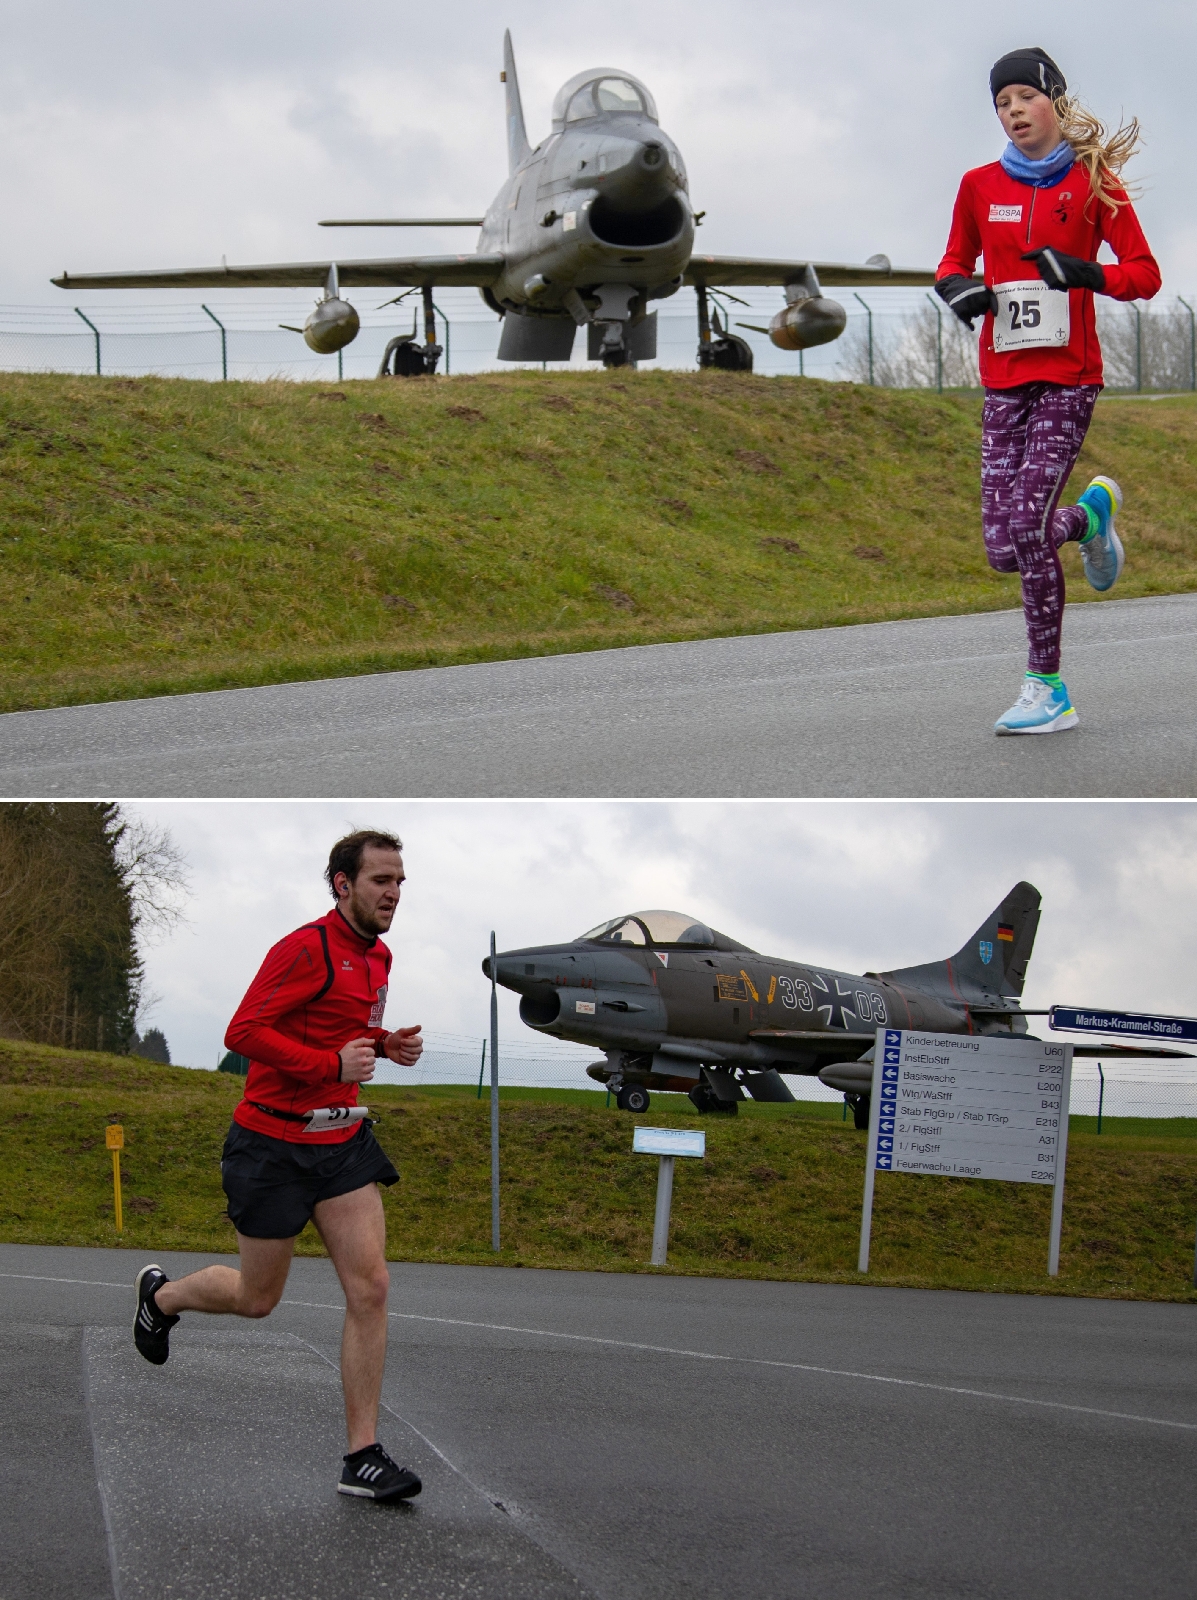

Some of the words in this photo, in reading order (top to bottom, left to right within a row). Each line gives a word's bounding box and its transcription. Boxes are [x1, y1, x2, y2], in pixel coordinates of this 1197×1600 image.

[1008, 300, 1041, 331] 25
[778, 975, 814, 1012] 33
[855, 990, 888, 1025] 03
[1075, 1014, 1183, 1034] Markus-Krammel-Straße
[906, 1036, 980, 1052] Kinderbetreuung
[1044, 1046, 1063, 1056] U60
[903, 1071, 956, 1083] Basiswache
[1038, 1064, 1063, 1074] E222
[1041, 1100, 1060, 1109] B43
[900, 1106, 922, 1116] Stab
[923, 1108, 955, 1120] FlgGrp
[963, 1111, 984, 1121] Stab
[987, 1113, 1009, 1124] TGrp
[1035, 1117, 1058, 1127] E218
[913, 1125, 942, 1136] FlgStff
[1038, 1135, 1055, 1145] A31
[911, 1142, 941, 1153] FlgStff
[1037, 1153, 1054, 1163] B31
[896, 1159, 951, 1172] Feuerwache
[953, 1164, 982, 1176] Laage
[1031, 1170, 1055, 1181] E226
